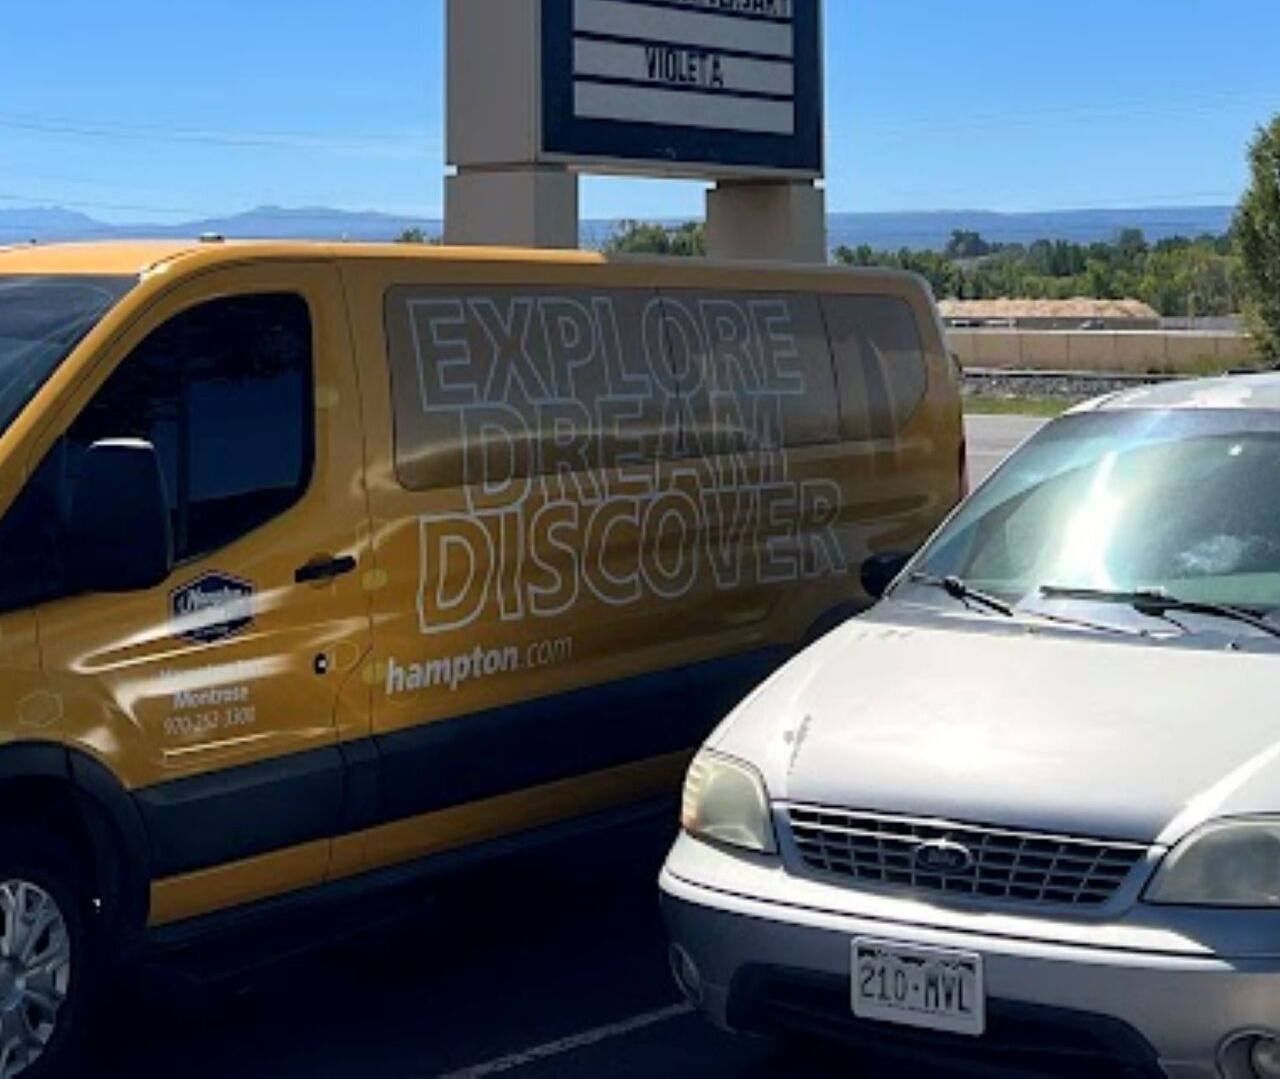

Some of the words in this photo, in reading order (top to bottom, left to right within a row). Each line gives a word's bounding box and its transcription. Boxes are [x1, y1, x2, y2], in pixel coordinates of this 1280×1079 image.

[645, 47, 724, 87] VIOLETA
[406, 296, 805, 411] EXPLORE
[461, 393, 789, 517] DREAM
[417, 478, 848, 633] DISCOVER
[385, 636, 572, 695] hampton.com
